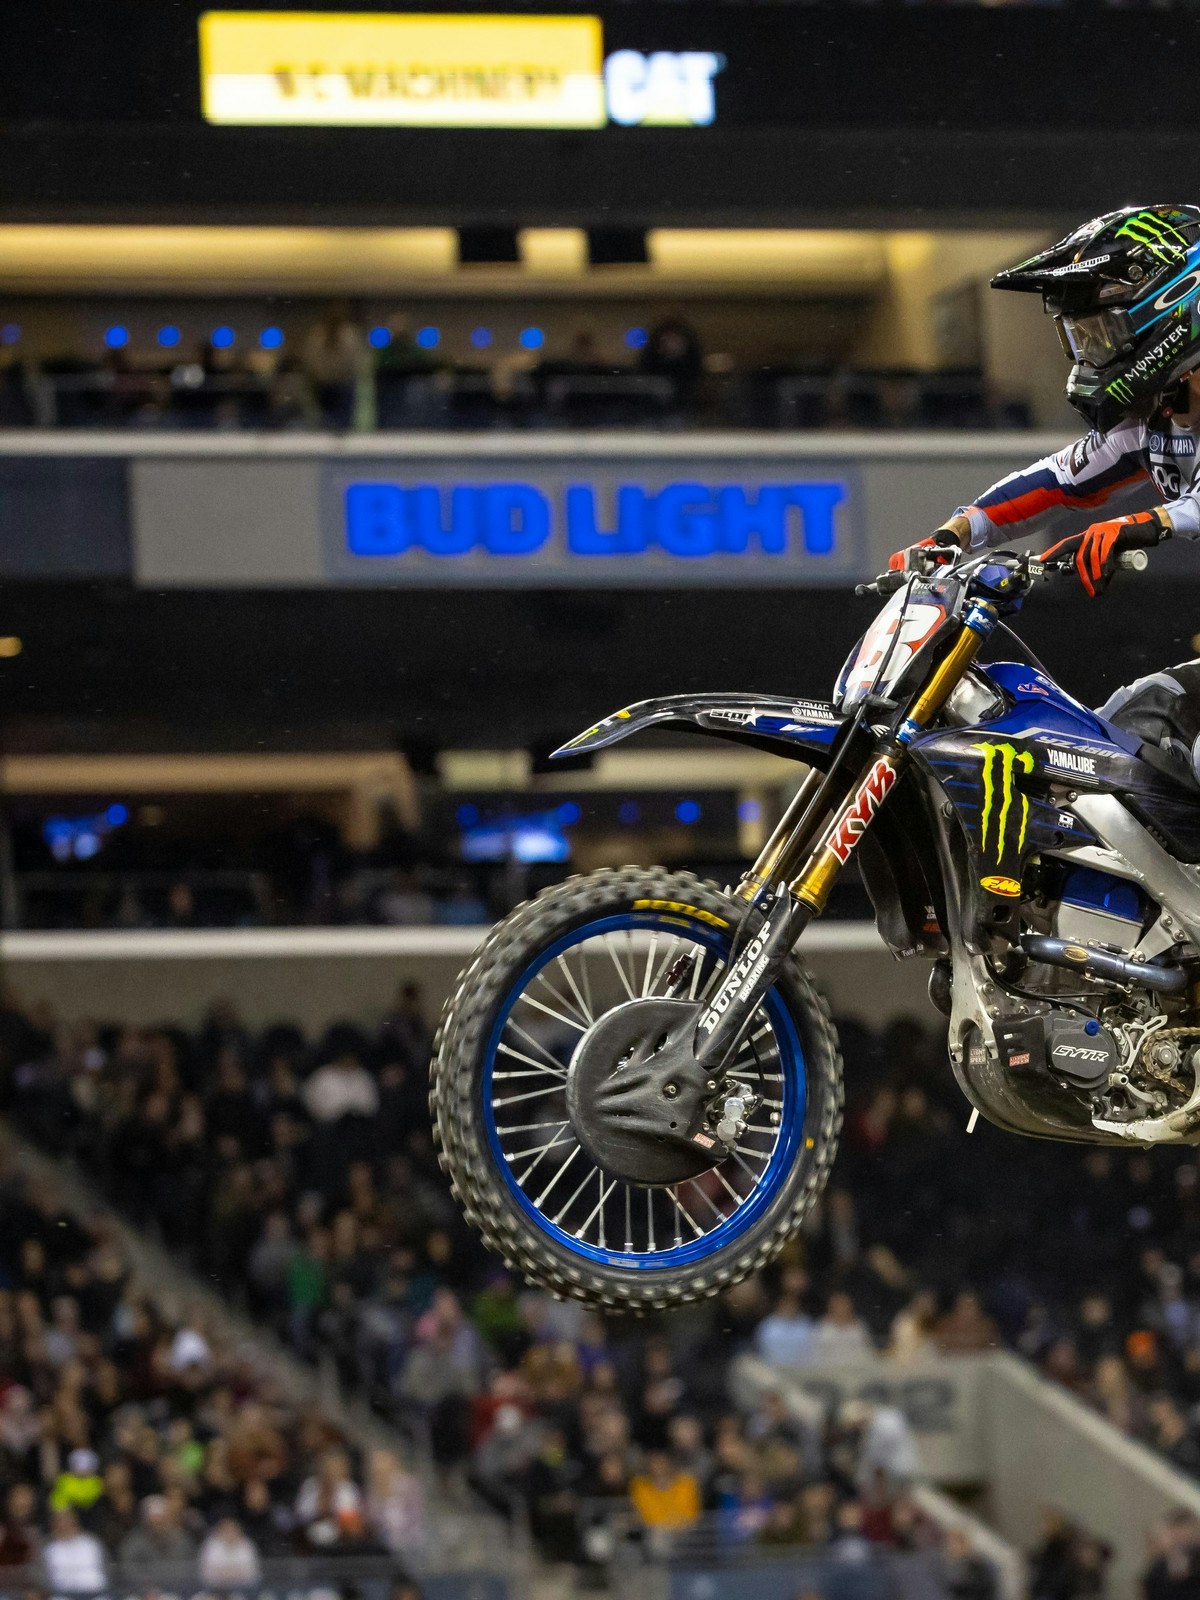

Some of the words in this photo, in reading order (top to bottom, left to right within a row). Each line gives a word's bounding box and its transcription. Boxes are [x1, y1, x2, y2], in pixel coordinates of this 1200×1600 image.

[1142, 341, 1184, 381] ENERGY
[1161, 437, 1194, 454] YAMAHA
[346, 481, 552, 557] BUD
[565, 481, 846, 557] LIGHT
[800, 708, 835, 720] YAMAHA
[1046, 748, 1097, 775] YAMALUBE
[825, 759, 897, 866] KYB
[703, 920, 771, 1035] DUNLOP
[739, 954, 769, 1003] BRAKING
[1052, 1045, 1109, 1062] GYTR
